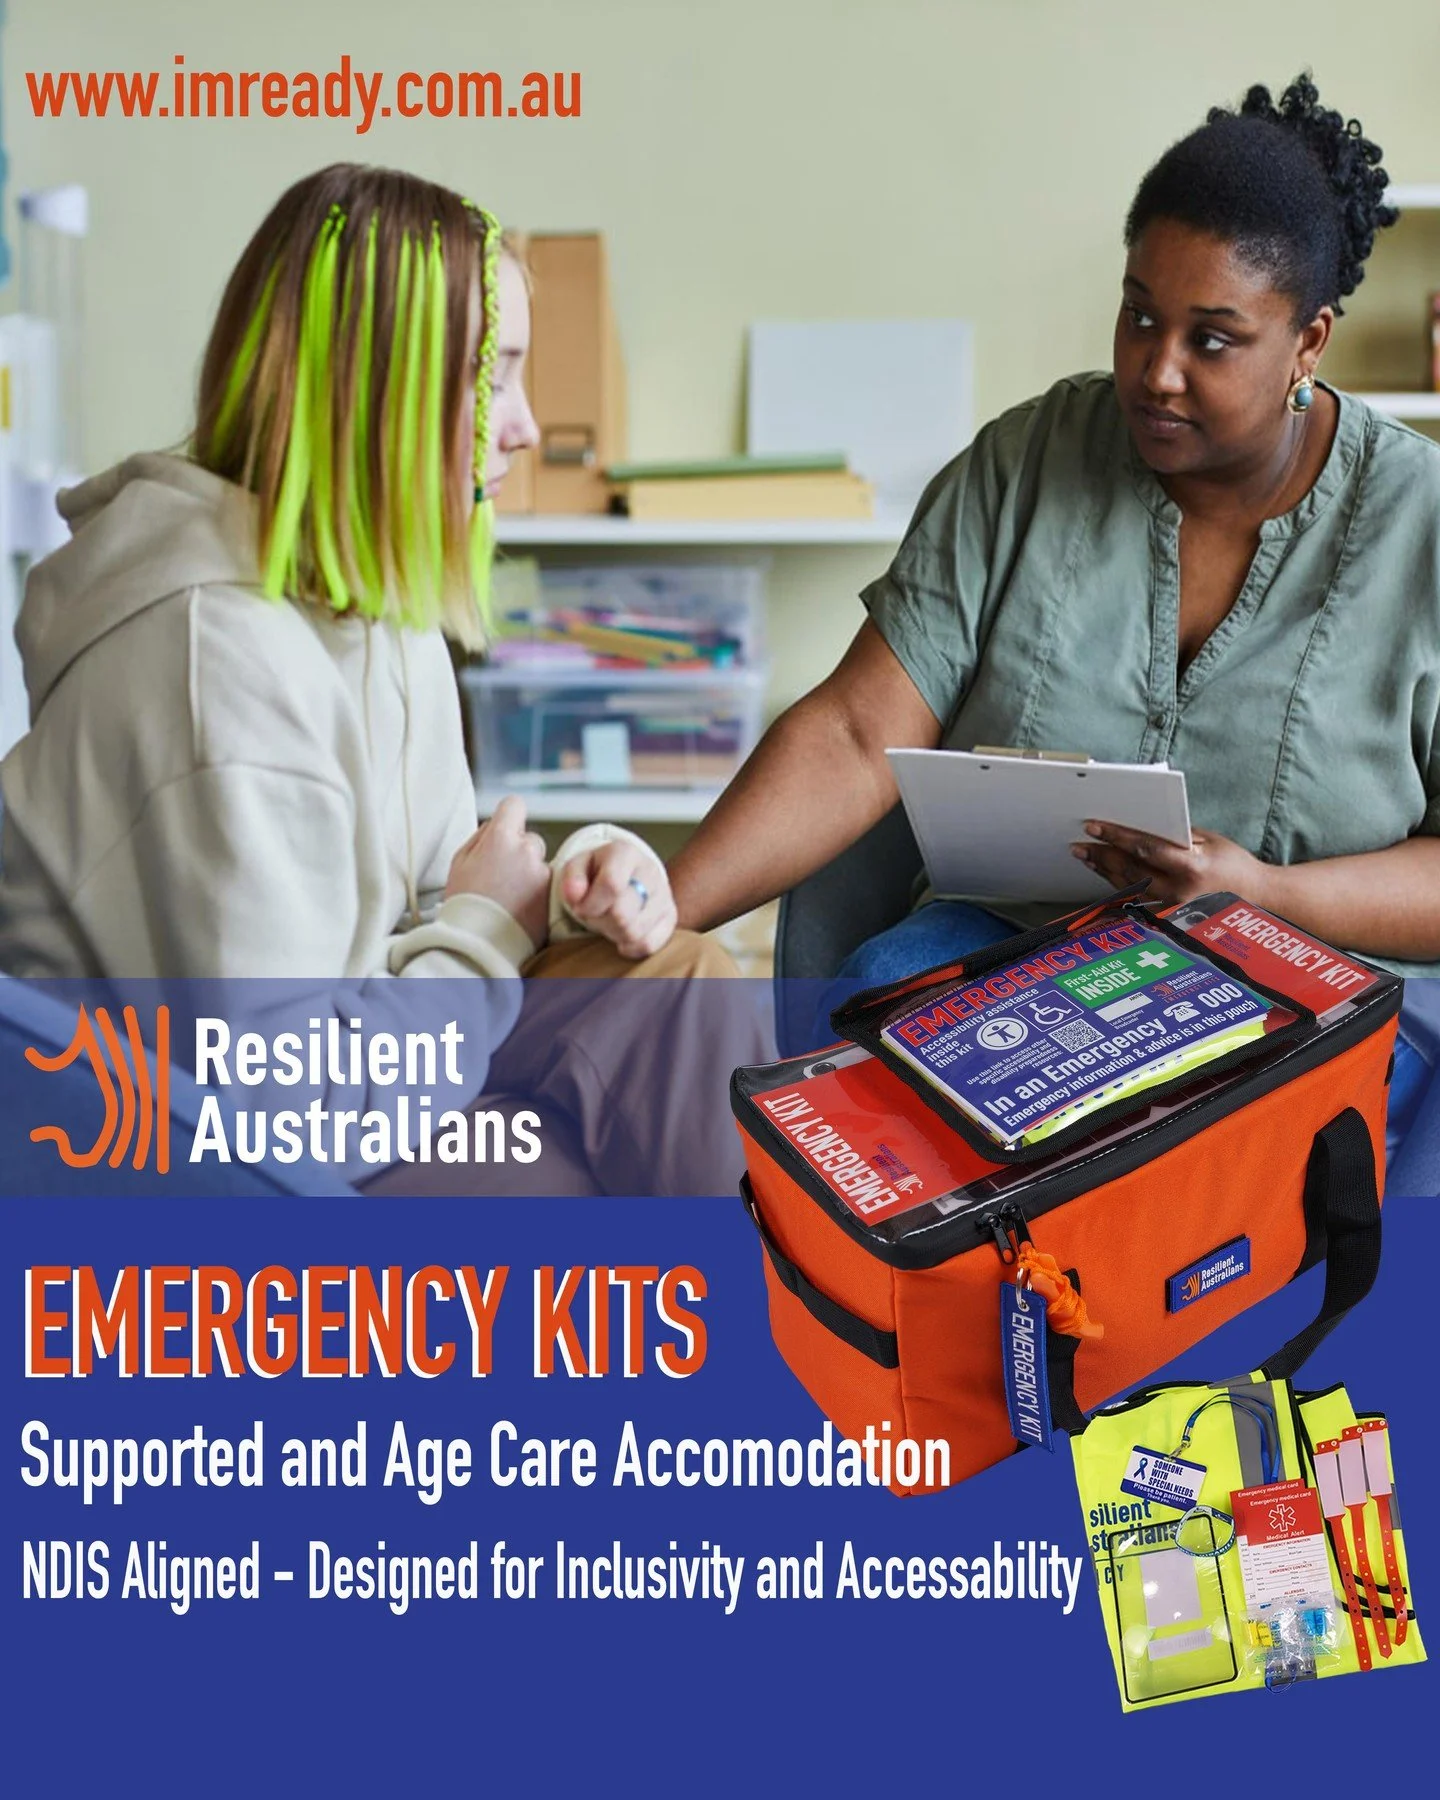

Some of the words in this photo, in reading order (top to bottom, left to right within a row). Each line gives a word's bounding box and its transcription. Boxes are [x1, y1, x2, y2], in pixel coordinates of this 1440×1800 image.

[1220, 908, 1334, 973] EMERGENCY
[1318, 962, 1366, 990] KIT
[897, 942, 1092, 1048] EMERGENCY
[1089, 924, 1147, 953] KIT
[1064, 965, 1110, 989] First-Aid
[1109, 959, 1126, 971] Kit
[1075, 968, 1141, 1001] INSIDE
[1166, 970, 1199, 986] Resilient
[1173, 971, 1213, 991] Australians
[1197, 982, 1243, 1009] 000
[920, 1012, 986, 1056] Accessibility
[985, 988, 1039, 1017] assistance
[926, 1039, 960, 1063] inside
[935, 1055, 958, 1069] this
[956, 1043, 974, 1057] kit
[966, 1077, 980, 1085] Use
[979, 1070, 993, 1078] this
[990, 1062, 1005, 1071] link
[1011, 1047, 1032, 1060] access
[1031, 1038, 1047, 1049] other
[979, 1069, 1003, 1085] specific
[1002, 1050, 1039, 1073] accessibility
[1039, 1042, 1052, 1051] and
[983, 1095, 1016, 1116] In
[1014, 1077, 1048, 1100] an
[1041, 1016, 1167, 1083] Emergency
[990, 1067, 1019, 1085] disability
[1019, 1046, 1058, 1071] preparedness
[1003, 1086, 1072, 1127] Emergency
[1068, 1053, 1137, 1091] information
[1136, 1046, 1147, 1058] &
[1144, 1030, 1182, 1056] advice
[1181, 1023, 1194, 1037] is
[1191, 1017, 1205, 1032] in
[1203, 1010, 1227, 1027] this
[1226, 999, 1258, 1025] pouch
[763, 1092, 815, 1123] KIT
[786, 1116, 901, 1215] EMERGENCY
[1200, 1261, 1245, 1292] Australians
[1201, 1254, 1235, 1281] Resilient
[1011, 1311, 1039, 1415] EMERGENCY
[1019, 1412, 1043, 1442] KIT
[1151, 1468, 1168, 1480] WITH
[1153, 1460, 1183, 1476] SOMEONE
[1133, 1482, 1155, 1493] Please
[1155, 1489, 1163, 1497] be
[1148, 1478, 1174, 1493] SPECIAL
[1173, 1485, 1194, 1498] NEEDS
[1238, 1488, 1267, 1498] Emergency
[1267, 1483, 1287, 1492] medical
[1250, 1497, 1279, 1507] Emergency
[1266, 1533, 1289, 1541] Medical
